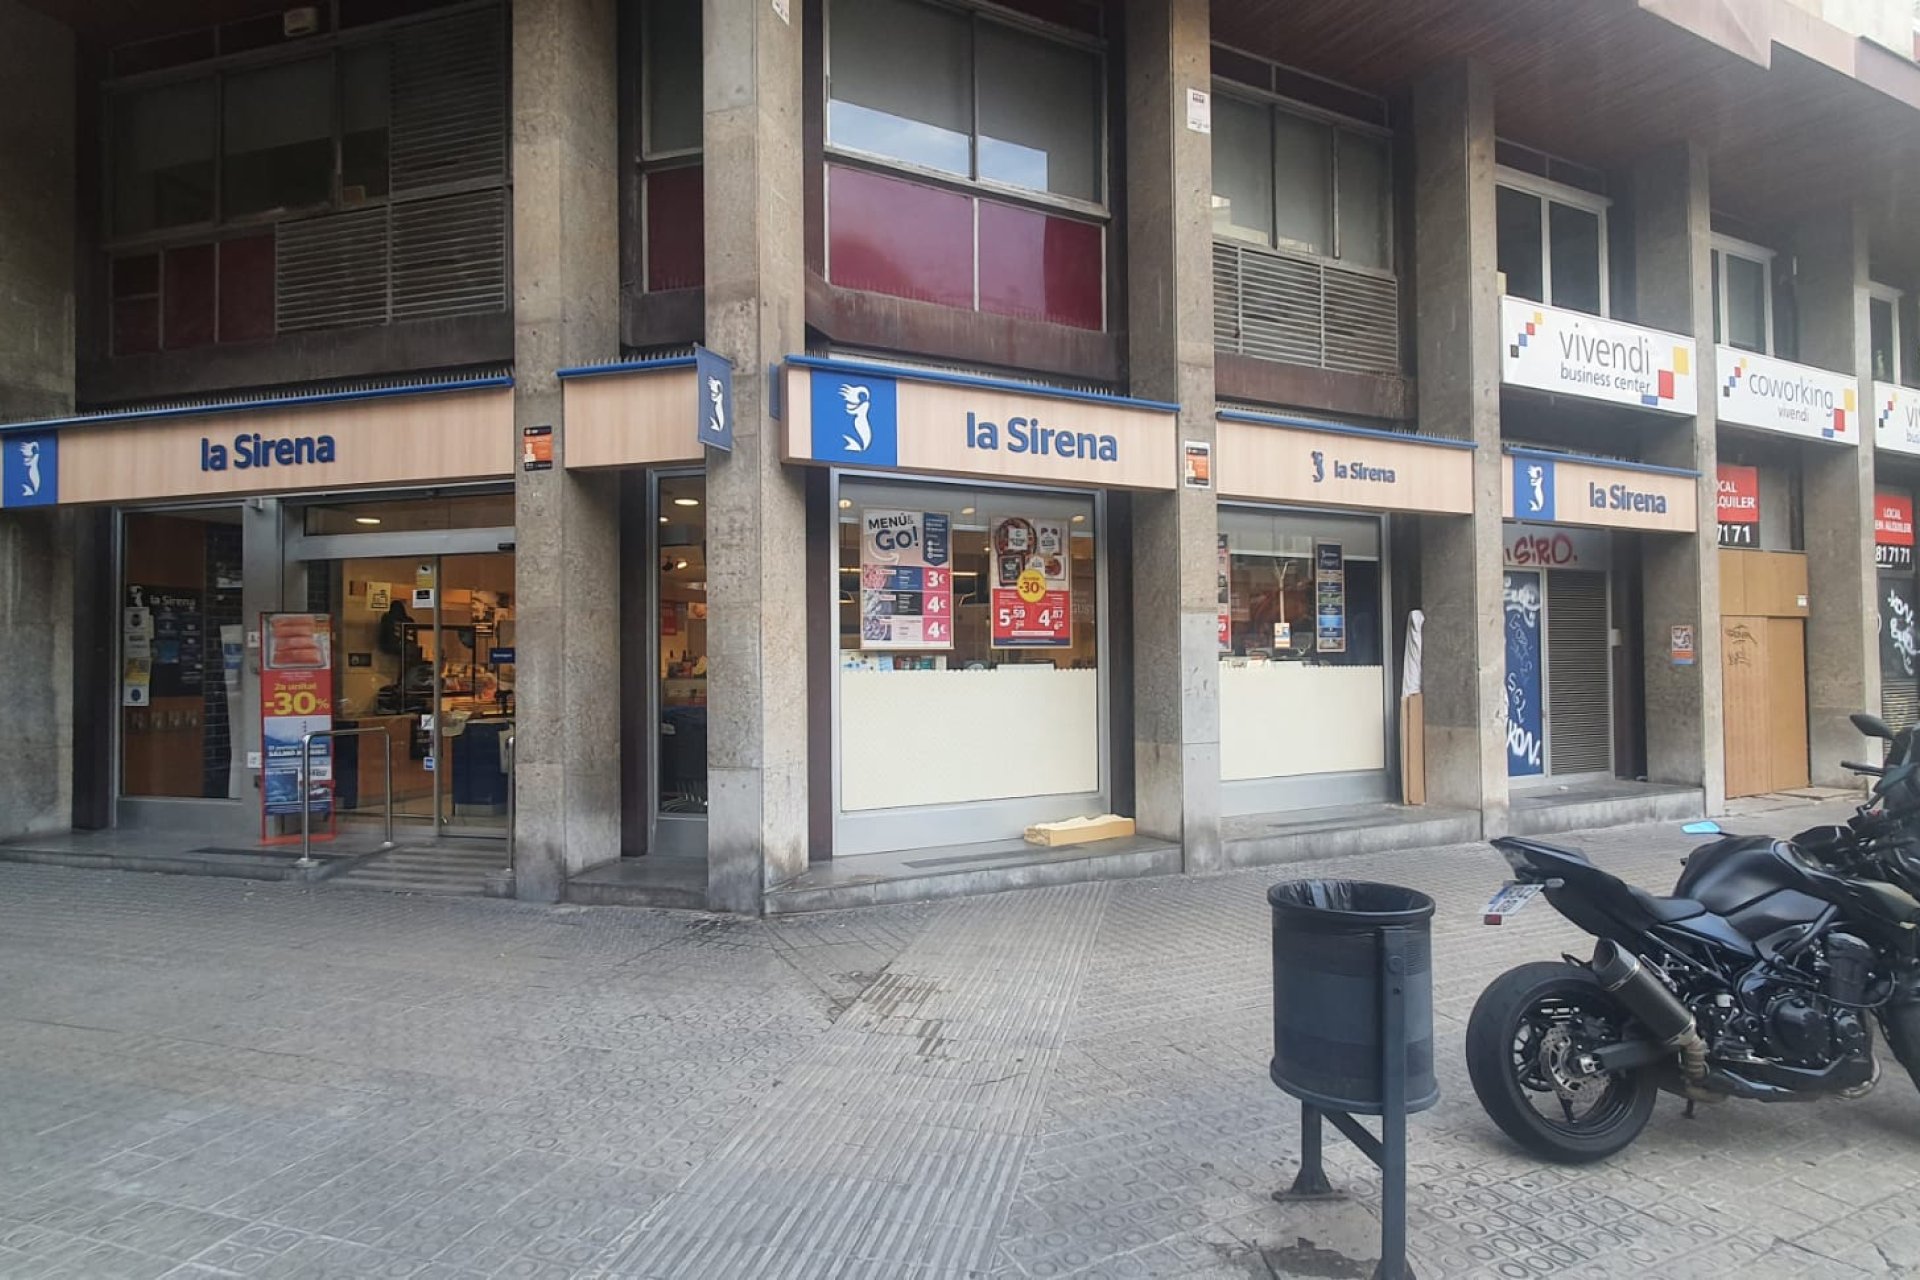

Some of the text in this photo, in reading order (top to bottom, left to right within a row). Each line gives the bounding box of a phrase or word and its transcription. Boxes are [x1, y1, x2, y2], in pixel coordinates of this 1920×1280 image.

[1559, 323, 1650, 375] vivendi
[1561, 362, 1651, 394] business center
[1750, 374, 1834, 417] coworking
[1778, 406, 1810, 422] vivendi
[201, 433, 336, 471] la Sirena
[967, 412, 1118, 462] la Sirena
[1334, 460, 1396, 483] la Sirena
[1589, 482, 1667, 513] la Sirena
[876, 526, 918, 550] GO!
[264, 691, 329, 714] -30%
